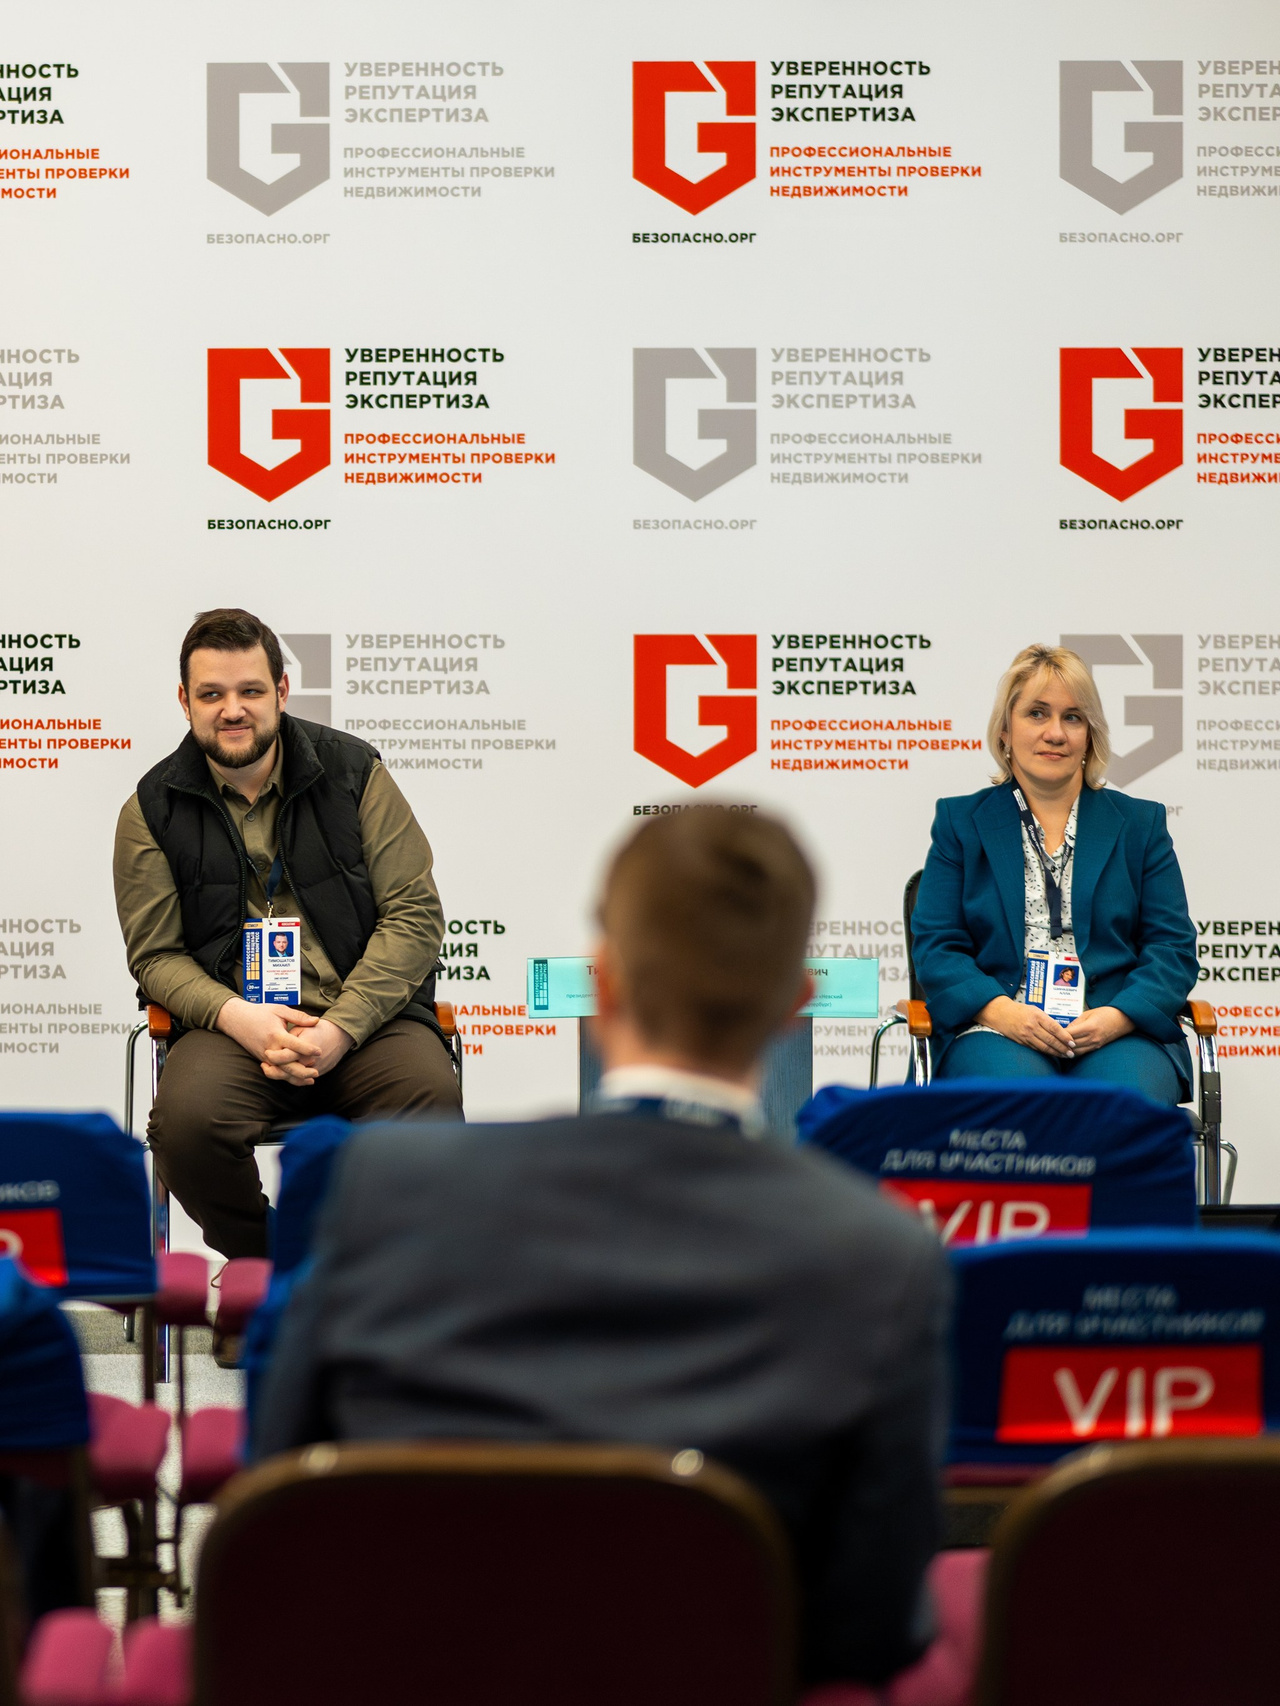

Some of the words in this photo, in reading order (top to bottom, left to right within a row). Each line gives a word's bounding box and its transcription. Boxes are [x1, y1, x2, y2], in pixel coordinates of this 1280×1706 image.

[344, 62, 503, 77] УВЕРЕННОСТЬ
[771, 61, 930, 75] УВЕРЕННОСТЬ
[345, 85, 476, 102] РЕПУТАЦИЯ
[771, 84, 902, 101] РЕПУТАЦИЯ
[345, 108, 489, 123] ЭКСПЕРТИЗА
[772, 107, 915, 122] ЭКСПЕРТИЗА
[344, 147, 525, 158] ПРОФЕССИОНАЛЬНЫЕ
[770, 146, 951, 157] ПРОФЕССИОНАЛЬНЫЕ
[45, 168, 129, 179] ПРОВЕРКИ
[344, 167, 464, 178] ИНСТРУМЕНТЫ
[470, 167, 554, 177] ПРОВЕРКИ
[770, 166, 891, 177] ИНСТРУМЕНТЫ
[897, 166, 981, 177] ПРОВЕРКИ
[344, 186, 481, 199] НЕДВИЖИМОСТИ
[770, 186, 907, 198] НЕДВИЖИМОСТИ
[1197, 185, 1280, 198] НЕДВИЖИ
[207, 234, 330, 244] БЕЗОПАСНО.ОРГ
[633, 233, 756, 243] БЕЗОПАСНО.ОРГ
[1059, 232, 1183, 243] БЕЗОПАСНО.ОРГ
[345, 348, 504, 363] УВЕРЕННОСТЬ
[771, 348, 930, 363] УВЕРЕННОСТЬ
[346, 371, 476, 388] РЕПУТАЦИЯ
[772, 371, 903, 388] РЕПУТАЦИЯ
[346, 394, 489, 409] ЭКСПЕРТИЗА
[772, 394, 916, 408] ЭКСПЕРТИЗА
[345, 433, 525, 444] ПРОФЕССИОНАЛЬНЫЕ
[771, 433, 951, 444] ПРОФЕССИОНАЛЬНЫЕ
[46, 453, 130, 464] ПРОВЕРКИ
[345, 453, 465, 464] ИНСТРУМЕНТЫ
[471, 453, 555, 464] ПРОВЕРКИ
[771, 453, 891, 464] ИНСТРУМЕНТЫ
[897, 453, 982, 464] ПРОВЕРКИ
[345, 472, 481, 485] НЕДВИЖИМОСТИ
[771, 472, 908, 485] НЕДВИЖИМОСТИ
[1197, 473, 1280, 485] НЕДВИЖИ
[208, 520, 331, 529] БЕЗОПАСНО.ОРГ
[633, 519, 757, 530] БЕЗОПАСНО.ОРГ
[1060, 520, 1183, 529] БЕЗОПАСНО.ОРГ
[346, 634, 504, 649] УВЕРЕННОСТЬ
[772, 635, 931, 649] УВЕРЕННОСТЬ
[346, 657, 477, 674] РЕПУТАЦИЯ
[772, 658, 903, 674] РЕПУТАЦИЯ
[347, 680, 490, 694] ЭКСПЕРТИЗА
[773, 681, 916, 695] ЭКСПЕРТИЗА
[345, 719, 526, 730] ПРОФЕССИОНАЛЬНЫЕ
[771, 720, 951, 731] ПРОФЕССИОНАЛЬНЫЕ
[47, 739, 131, 749] ПРОВЕРКИ
[369, 739, 466, 750] СТРУМЕНТЫ
[471, 739, 555, 750] ПРОВЕРКИ
[771, 740, 892, 750] ИНСТРУМЕНТЫ
[897, 740, 981, 750] ПРОВЕРКИ
[385, 758, 483, 769] ИЖИМОСТИ
[771, 759, 908, 771] НЕДВИЖИМОСТИ
[1197, 759, 1280, 771] НЕДВИЖИ
[633, 805, 757, 815] БЕЗОПОРГ
[816, 921, 903, 935] РЕННОС
[807, 944, 903, 958] ПУТАЦИЯ
[48, 1023, 131, 1034] ПРОВЕРКИ
[472, 1025, 556, 1035] ПРОВЕРКИ
[1219, 1026, 1280, 1036] СТРУМЕ
[814, 1045, 908, 1056] ИЖИМОСТИ
[1053, 1366, 1215, 1437] VIP
